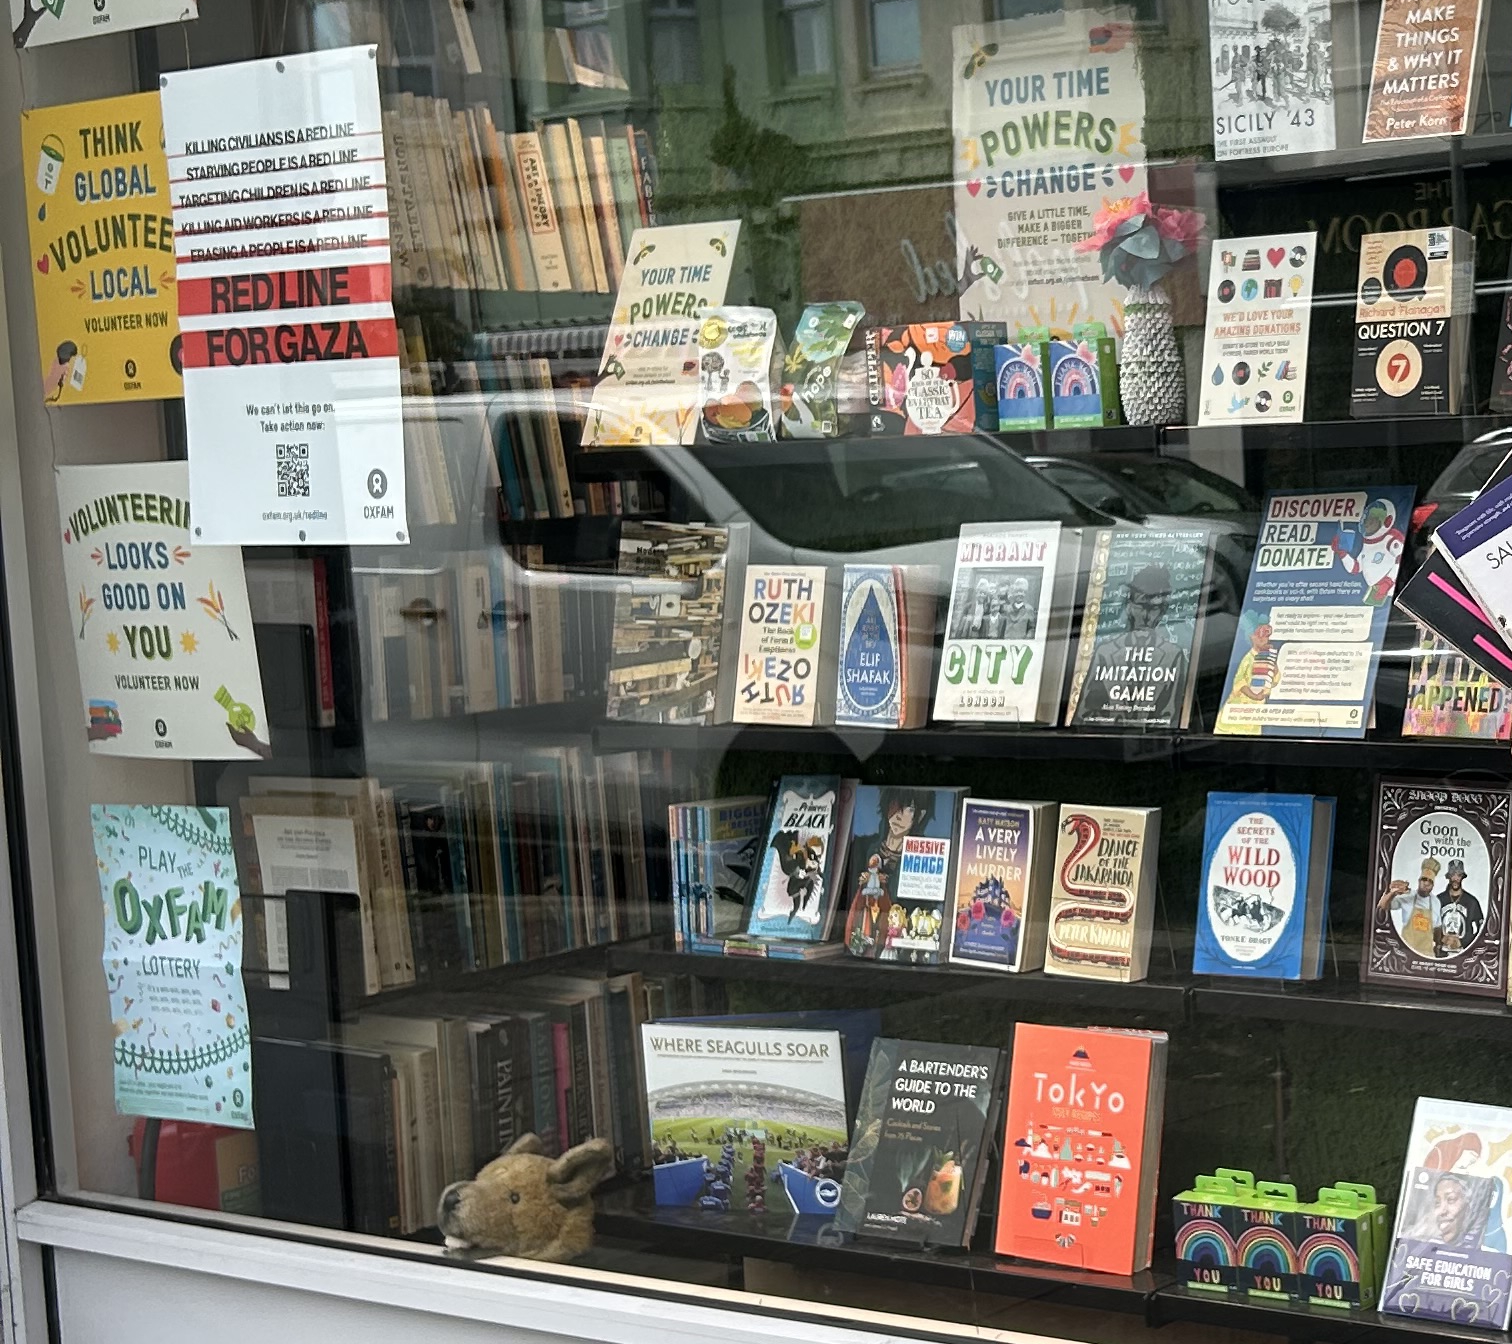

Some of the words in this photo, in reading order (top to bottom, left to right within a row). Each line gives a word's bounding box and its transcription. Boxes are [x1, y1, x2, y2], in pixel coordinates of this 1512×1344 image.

[1405, 5, 1455, 24] MAKE
[1395, 27, 1460, 49] THINGS
[1387, 57, 1400, 72] &
[1403, 51, 1445, 69] WHY
[1447, 49, 1463, 65] IT
[985, 74, 1045, 106] YOUR
[1053, 66, 1110, 100] TIME
[1382, 72, 1460, 96] MATTERS
[79, 121, 142, 159] THINK
[185, 139, 227, 156] KILLING
[227, 131, 284, 151] CIVILIANS
[285, 130, 295, 144] IS
[297, 130, 304, 143] A
[306, 126, 328, 141] RED
[329, 122, 355, 138] LINE
[980, 110, 1117, 167] POWERS
[186, 160, 241, 181] STARVING
[240, 156, 287, 174] PEOPLE
[288, 155, 299, 170] IS
[300, 155, 307, 169] A
[308, 151, 331, 167] RED
[333, 149, 358, 163] LINE
[74, 164, 157, 203] GLOBAL
[1001, 162, 1097, 198] CHANGE
[179, 189, 240, 208] TARGETING
[241, 183, 300, 204] CHILDREN
[300, 182, 310, 196] IS
[311, 182, 319, 194] A
[320, 179, 344, 194] RED
[345, 176, 371, 191] LINE
[181, 221, 223, 236] KILLING
[224, 219, 243, 233] AID
[243, 212, 300, 230] WORKERS
[301, 211, 312, 225] IS
[313, 211, 321, 224] A
[322, 208, 346, 223] RED
[347, 206, 373, 219] LINE
[1008, 211, 1027, 222] GIVE
[1029, 210, 1036, 220] A
[1037, 208, 1066, 220] LITTLE
[1066, 206, 1092, 218] TIME,
[1017, 223, 1042, 234] MAKE
[1043, 223, 1050, 232] A
[1051, 220, 1082, 232] BIGGER
[997, 233, 1049, 249] DIFFERENCE
[90, 265, 158, 302] LOCAL
[641, 267, 675, 287] YOUR
[680, 264, 713, 284] TIME
[211, 272, 274, 314] RED
[279, 266, 349, 309] LINE
[633, 327, 688, 348] CHANGE
[1358, 321, 1431, 340] QUESTION
[1435, 321, 1446, 336] 7
[207, 328, 270, 368] FOR
[274, 321, 369, 364] GAZA
[865, 330, 880, 406] CLIPPER
[908, 386, 950, 397] CLASSIC
[917, 408, 944, 420] TEA
[363, 505, 394, 519] OXFAM
[1270, 499, 1360, 518] DISCOVER.
[105, 541, 170, 570] LOOKS
[959, 541, 1048, 563] MIGRANT
[101, 582, 150, 611] GOOD
[156, 582, 186, 610] ON
[754, 577, 813, 601] RUTH
[749, 602, 815, 625] OZEKI
[123, 625, 174, 660] YOU
[859, 652, 881, 668] ELIF
[944, 644, 1034, 686] CITY
[1125, 646, 1155, 663] THE
[846, 668, 891, 685] SHAFAK
[1094, 666, 1177, 683] IMITATION
[958, 695, 1006, 708] LONDON
[1109, 685, 1156, 702] GAME
[784, 813, 829, 829] BLACK
[1237, 827, 1275, 835] SECRETS
[1248, 817, 1264, 825] THE
[1420, 820, 1459, 837] Goon
[975, 827, 985, 841] A
[987, 828, 1021, 844] VERY
[1434, 836, 1455, 846] with
[1456, 837, 1472, 848] the
[904, 839, 946, 855] MASSIVE
[975, 845, 1018, 863] LIVELY
[1100, 837, 1140, 859] DANCE
[1228, 846, 1281, 866] WILD
[1420, 840, 1465, 859] Spoon
[138, 845, 177, 874] PLAY
[1099, 858, 1110, 868] OF
[1112, 858, 1130, 869] THE
[967, 863, 1022, 882] MURDER
[1223, 866, 1281, 888] WOOD
[141, 955, 201, 980] LOTTERY
[650, 1036, 703, 1053] WHERE
[706, 1039, 782, 1057] SEAGULLS
[787, 1042, 829, 1058] SOAR
[898, 1059, 908, 1072] A
[908, 1060, 990, 1080] BARTENDER'S
[895, 1078, 932, 1095] GUIDE
[934, 1081, 951, 1096] TO
[953, 1083, 978, 1099] THE
[891, 1097, 936, 1114] WORLD
[1180, 1203, 1222, 1219] THANK
[1241, 1209, 1284, 1226] THANK
[1303, 1216, 1346, 1233] THANK
[1419, 1272, 1442, 1287] FOR
[1443, 1275, 1475, 1293] GIRLS
